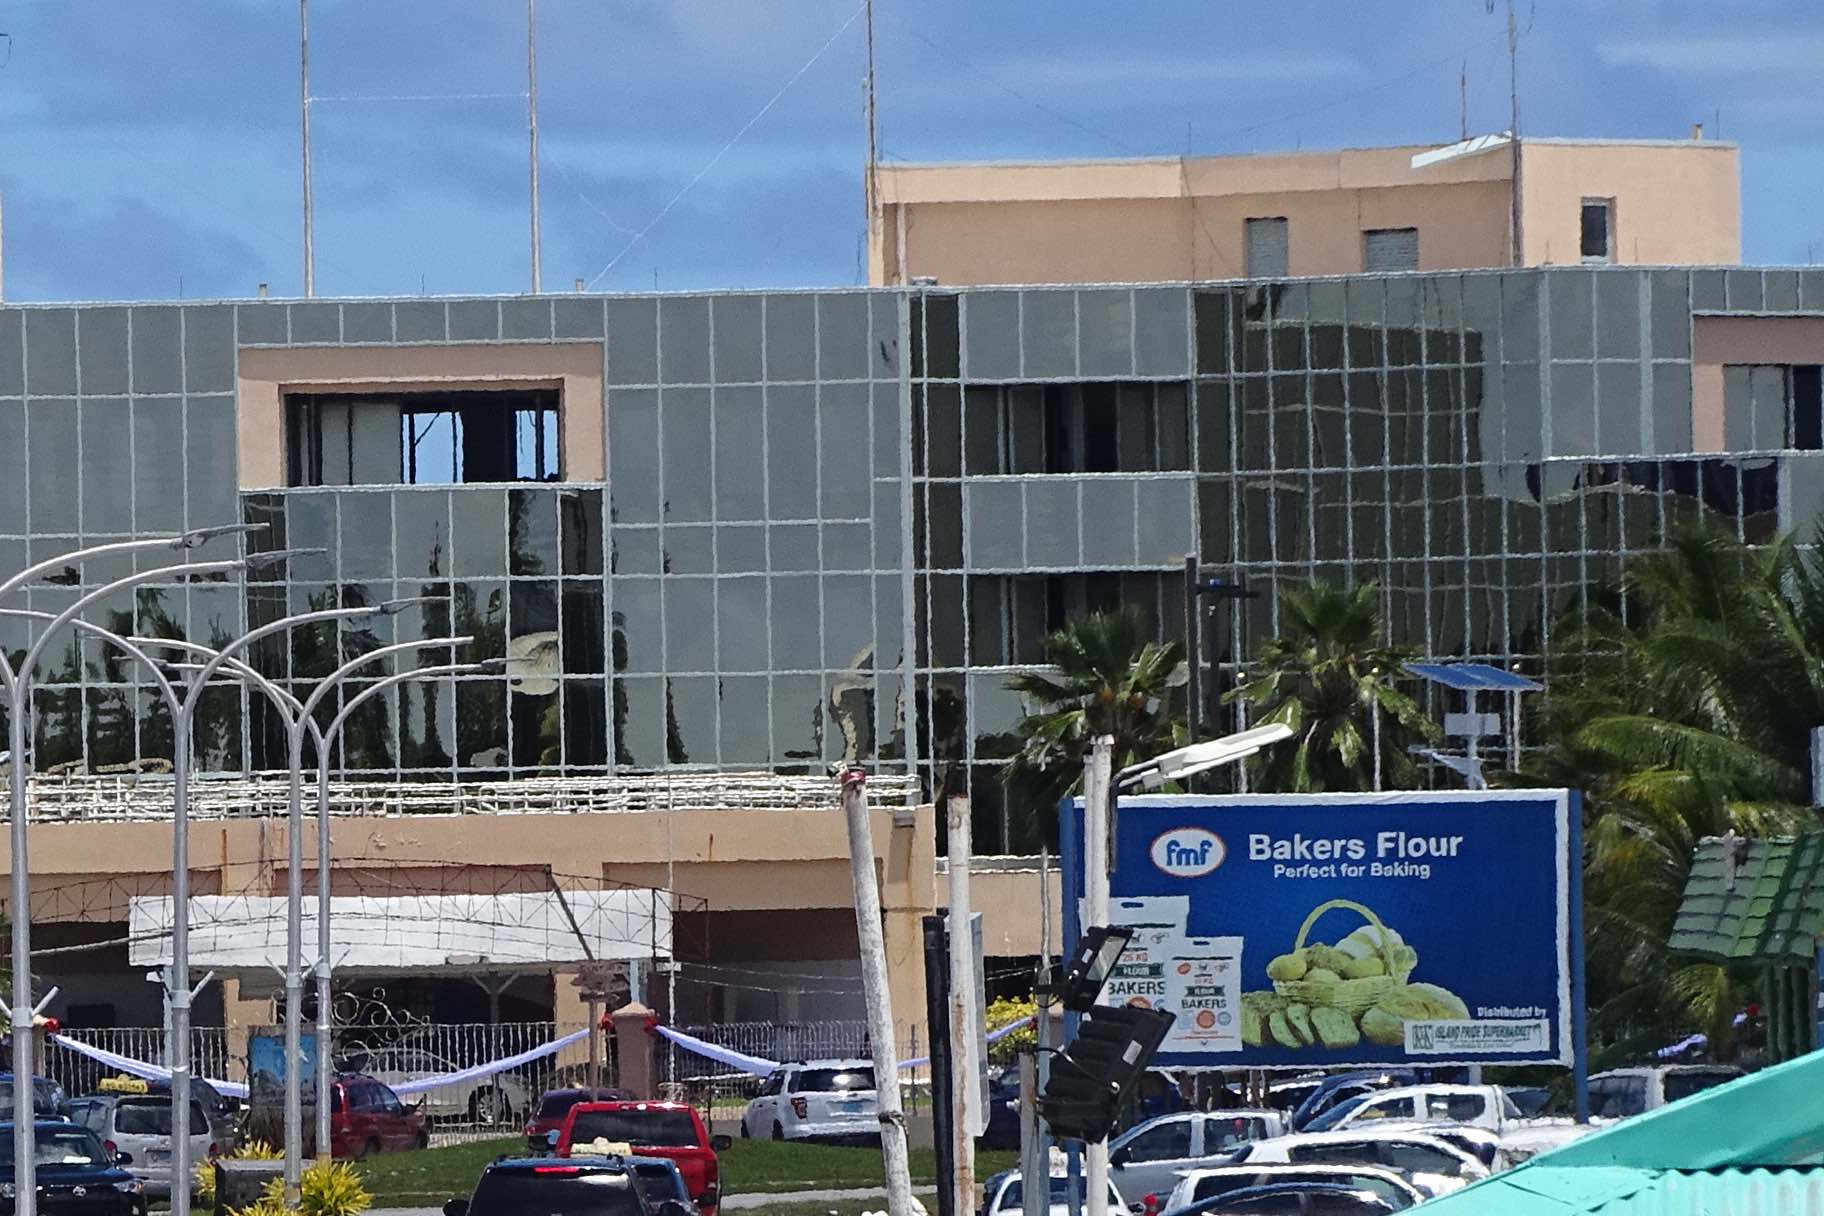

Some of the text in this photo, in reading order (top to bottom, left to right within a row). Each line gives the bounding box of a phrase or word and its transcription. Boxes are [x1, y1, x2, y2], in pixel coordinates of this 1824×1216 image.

[1166, 839, 1213, 866] fmf
[1249, 831, 1463, 860] Bakers Flour
[1274, 862, 1431, 879] Perfect for Baking
[1181, 999, 1227, 1009] BAKERS
[1477, 1007, 1547, 1018] Distributed by
